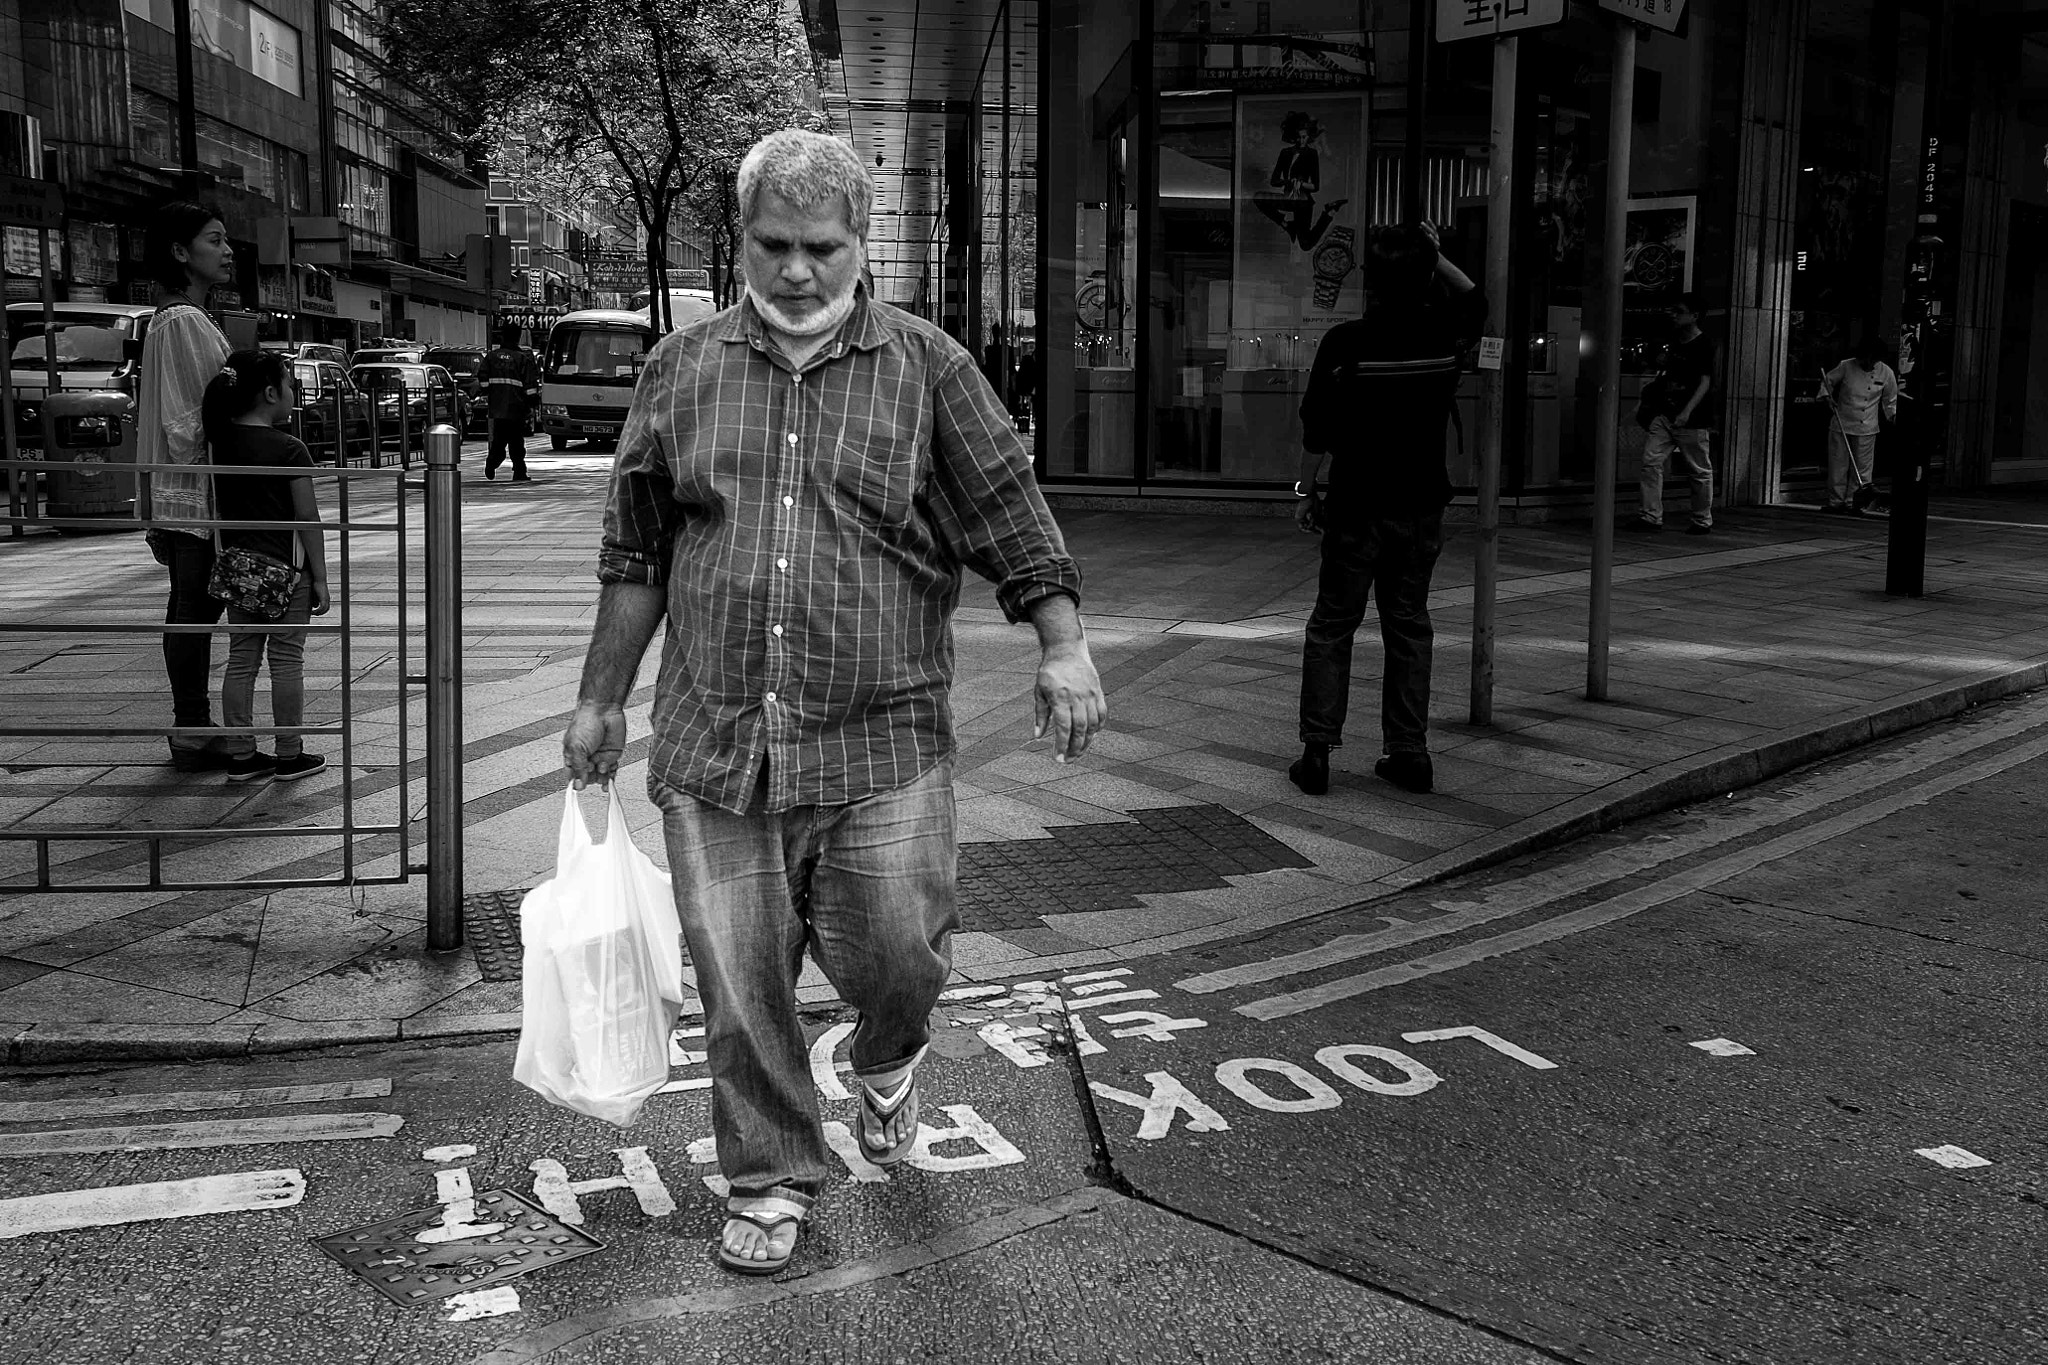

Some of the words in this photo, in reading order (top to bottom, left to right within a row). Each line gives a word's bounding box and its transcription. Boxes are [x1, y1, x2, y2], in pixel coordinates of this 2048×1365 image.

[1924, 163, 1936, 203] 2043
[592, 262, 647, 272] Koh-i-Noor
[1089, 1025, 1559, 1141] LOOK
